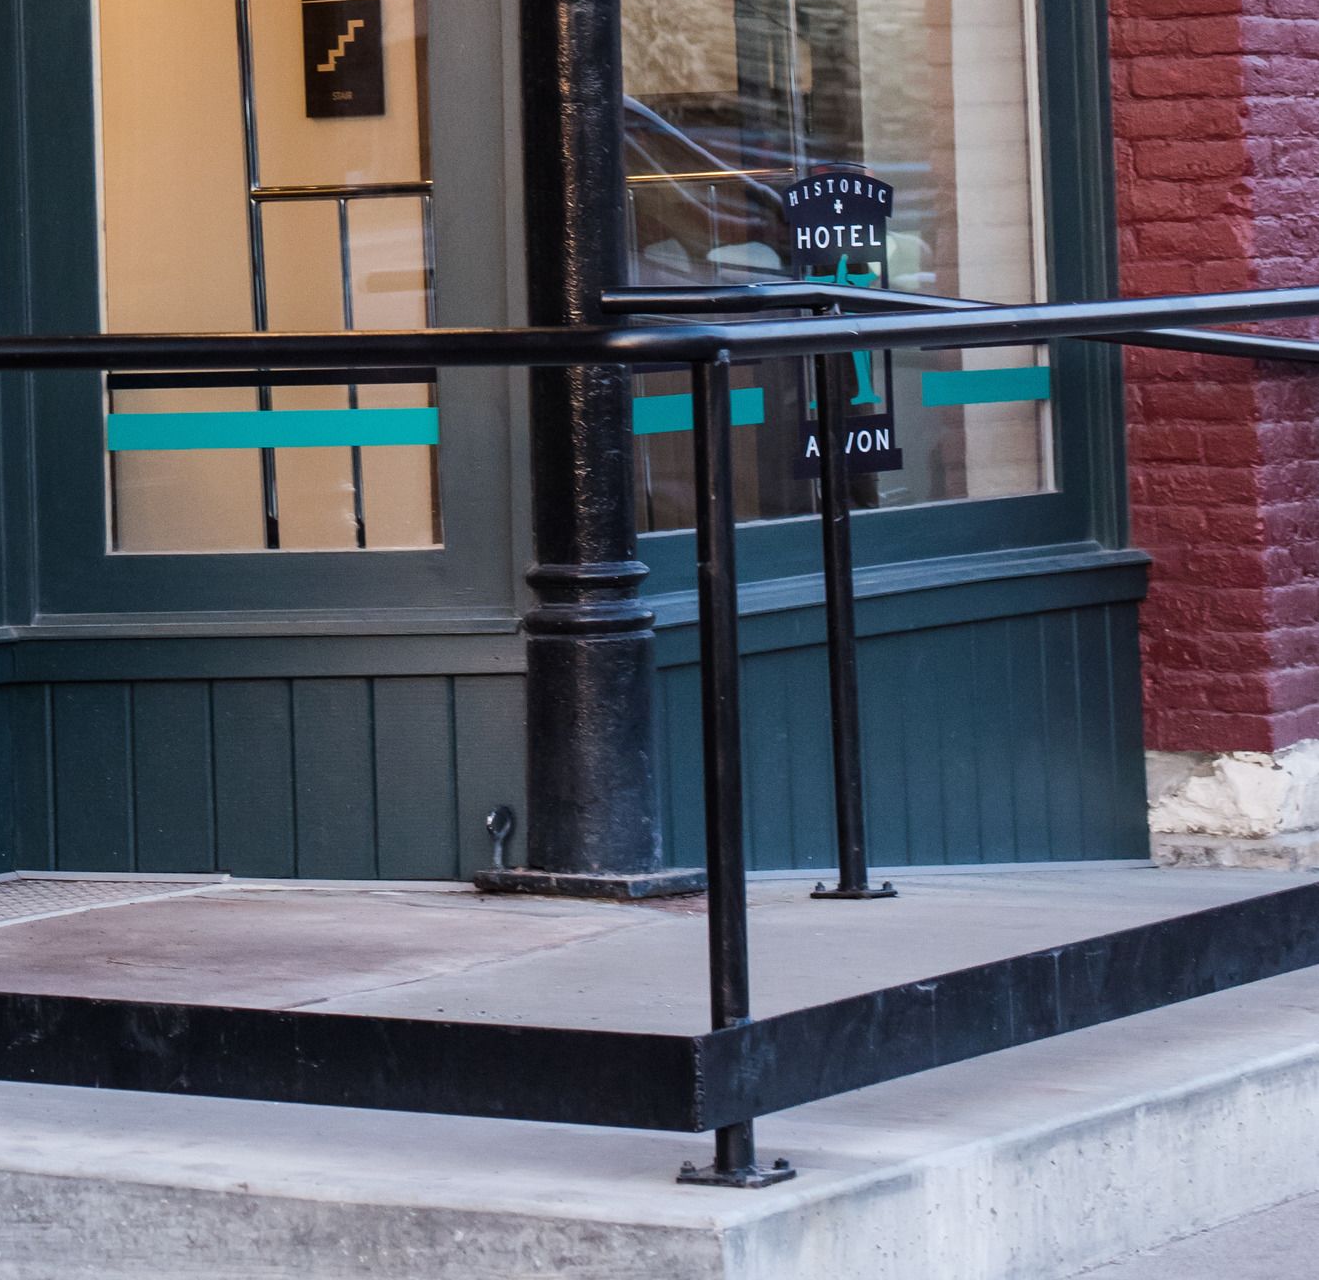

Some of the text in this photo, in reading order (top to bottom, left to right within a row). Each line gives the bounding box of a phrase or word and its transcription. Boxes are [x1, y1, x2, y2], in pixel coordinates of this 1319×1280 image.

[788, 178, 887, 207] HISTORIC
[796, 224, 882, 250] HOTEL
[805, 428, 890, 458] AVON
